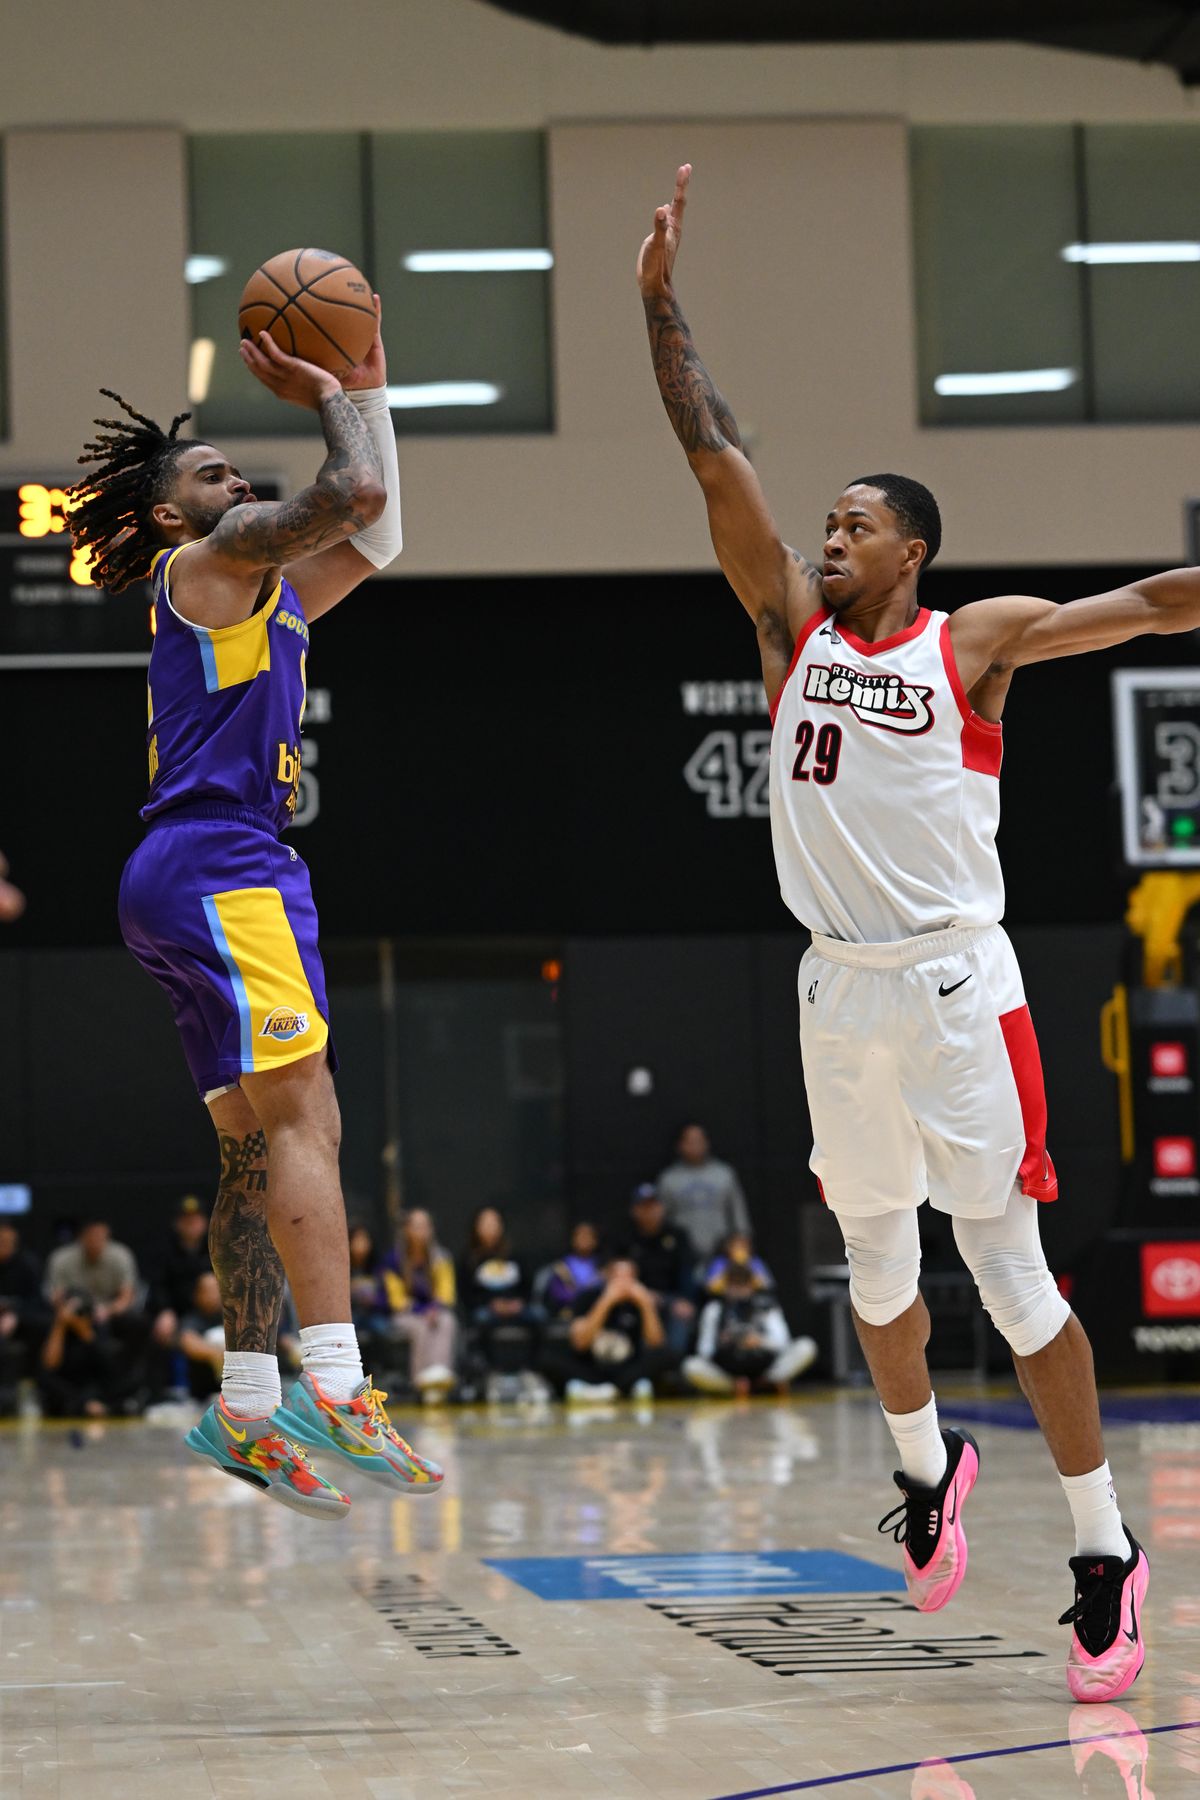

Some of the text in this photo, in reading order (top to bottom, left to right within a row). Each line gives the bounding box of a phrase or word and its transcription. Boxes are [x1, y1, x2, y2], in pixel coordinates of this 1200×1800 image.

[276, 609, 309, 645] SOUT
[832, 665, 887, 687] RIP CITY
[804, 665, 932, 733] Remix
[792, 719, 843, 785] 29
[262, 1017, 306, 1036] LAKERS
